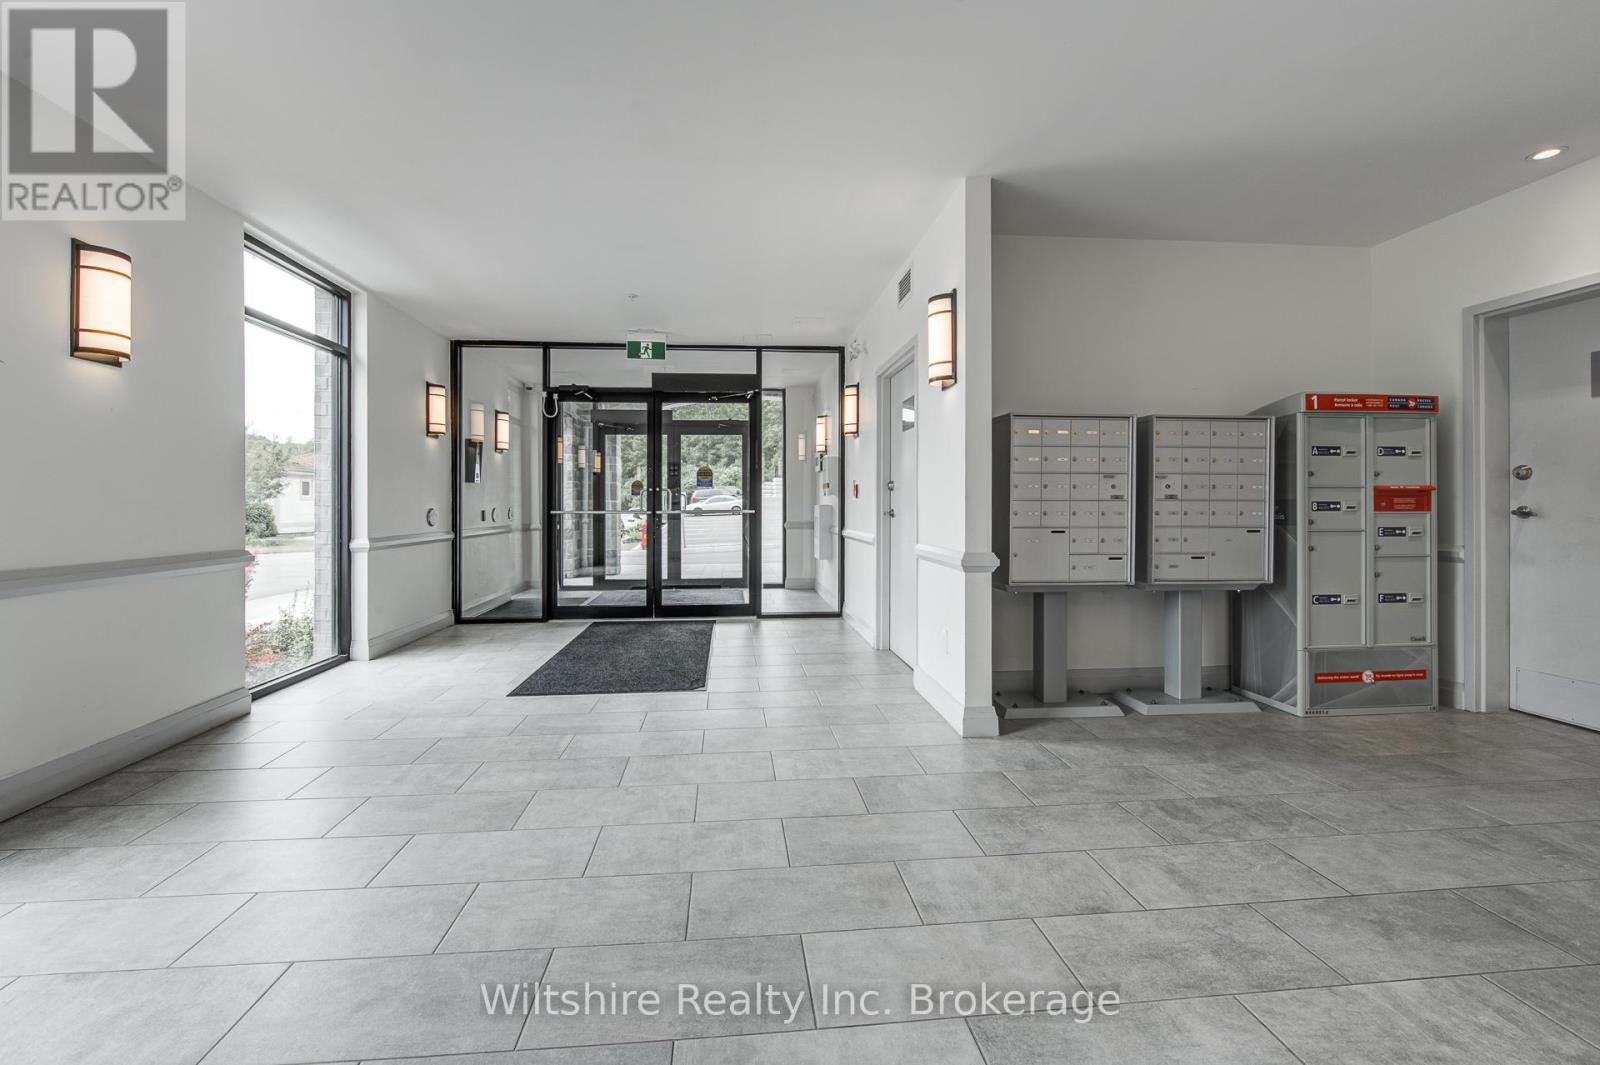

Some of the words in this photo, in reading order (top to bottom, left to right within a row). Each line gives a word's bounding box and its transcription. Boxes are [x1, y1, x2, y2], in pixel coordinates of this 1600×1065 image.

[1311, 395, 1318, 409] 1
[1312, 447, 1318, 455] A
[1312, 502, 1318, 510] B
[1379, 528, 1384, 536] E
[1313, 596, 1319, 604] C
